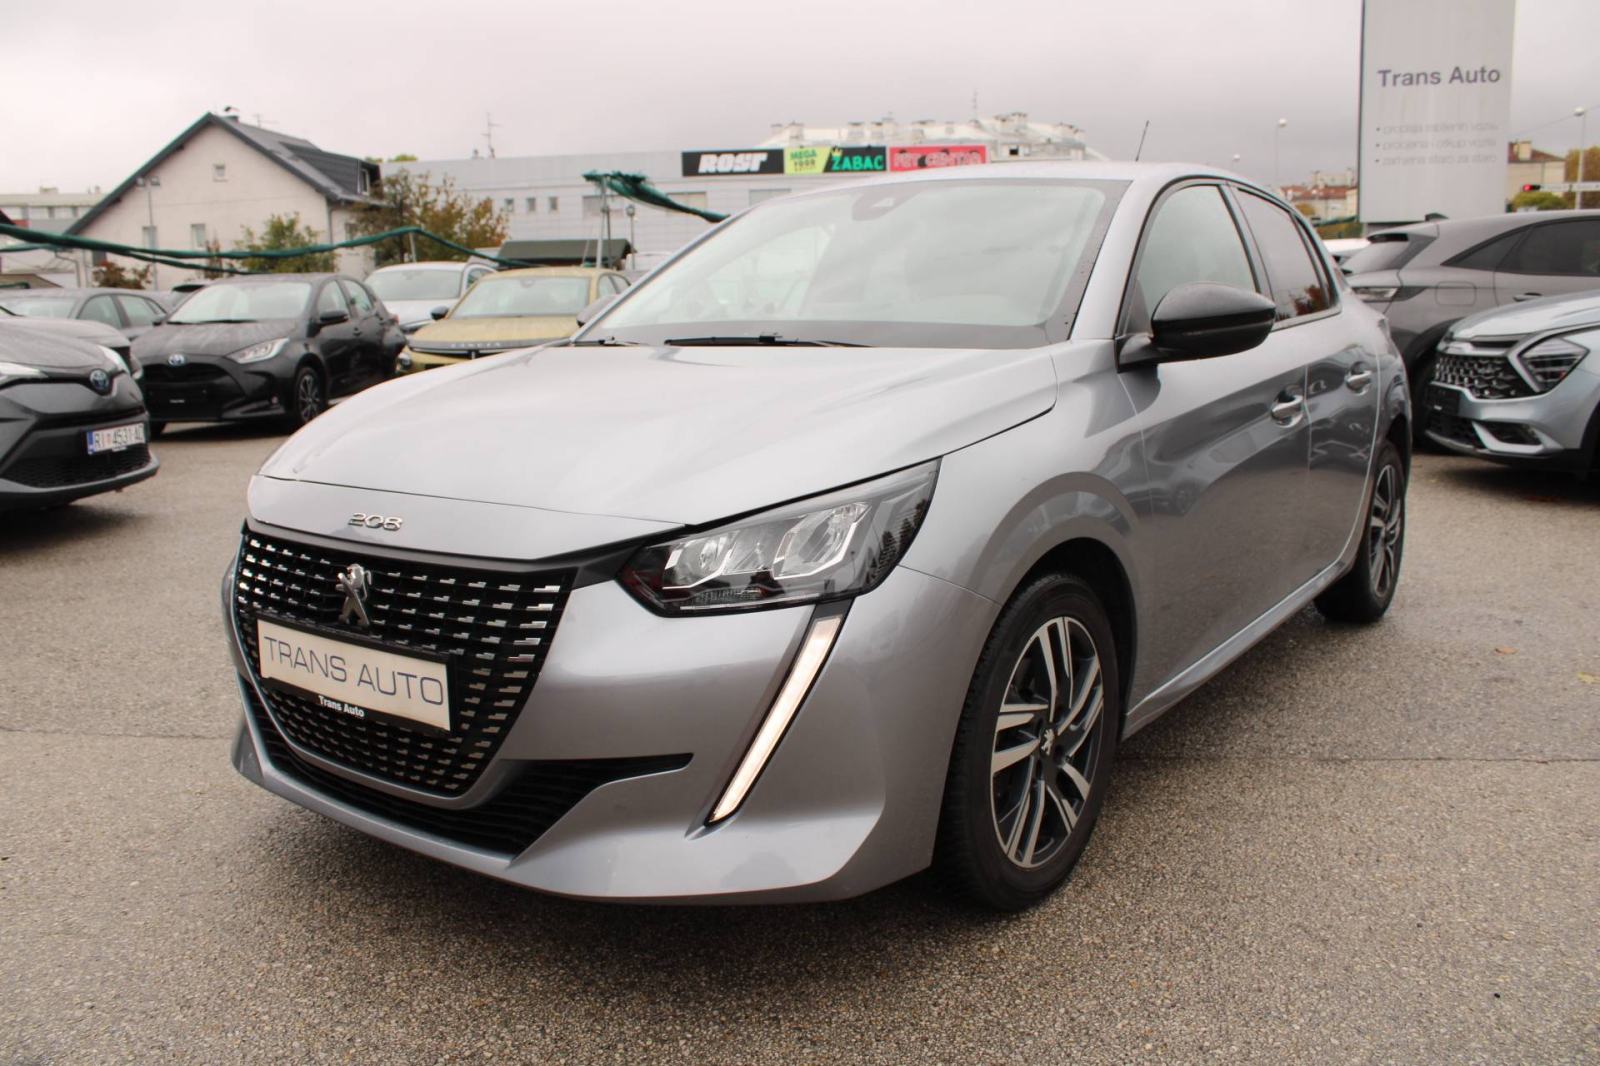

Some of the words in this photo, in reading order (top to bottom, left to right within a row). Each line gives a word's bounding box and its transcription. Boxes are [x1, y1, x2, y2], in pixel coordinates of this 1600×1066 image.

[1378, 69, 1441, 87] Trans
[1449, 66, 1501, 84] Auto
[790, 149, 817, 160] MEGA
[348, 512, 402, 531] 208
[263, 636, 348, 683] TRANS
[357, 663, 445, 706] AUTO
[318, 695, 343, 712] Trans
[343, 702, 365, 718] Auto
